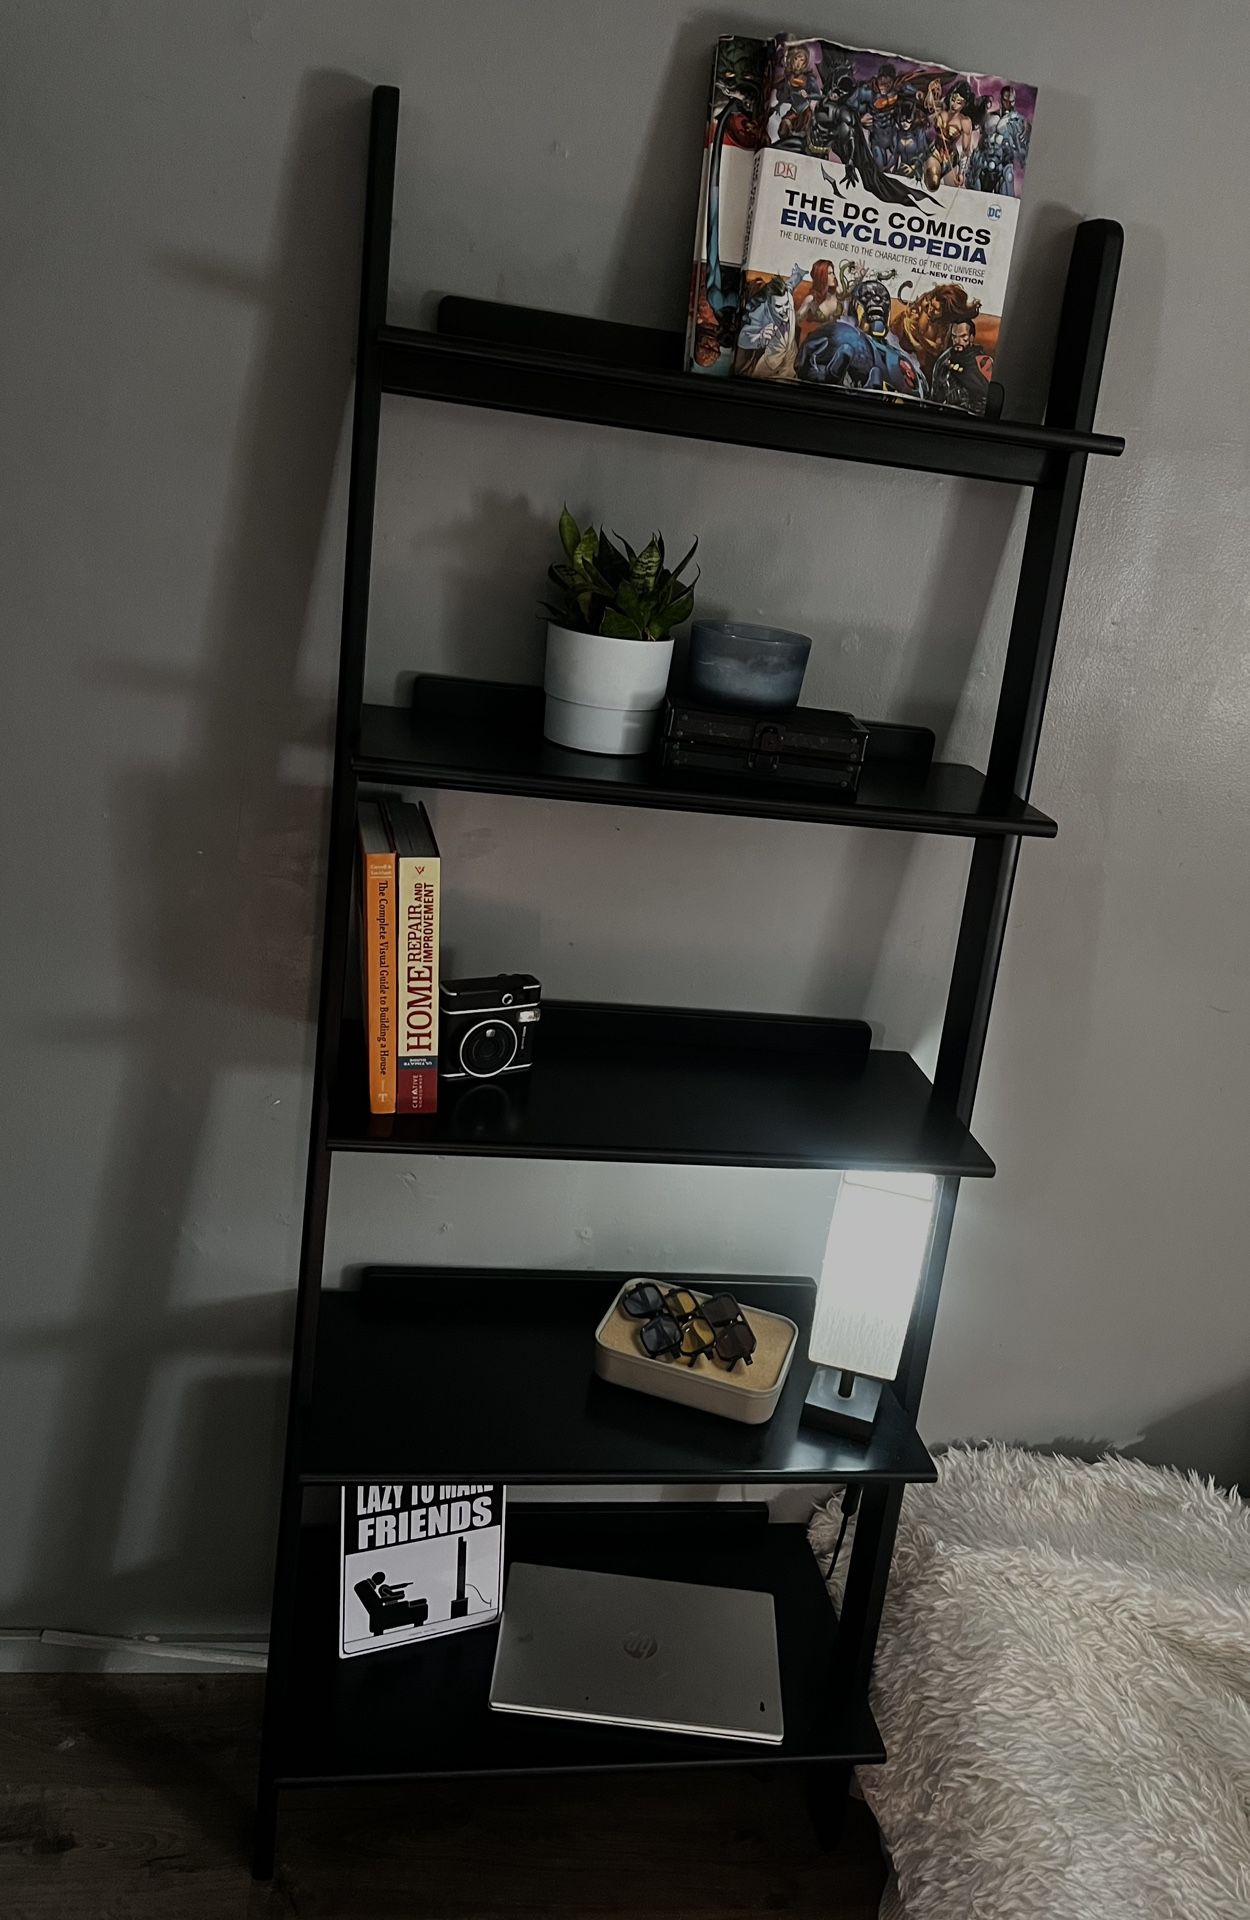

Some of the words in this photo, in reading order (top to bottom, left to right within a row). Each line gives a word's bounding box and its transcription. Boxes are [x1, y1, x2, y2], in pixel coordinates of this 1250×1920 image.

[777, 163, 794, 176] DK
[785, 190, 834, 215] THE
[843, 203, 879, 224] DC
[888, 212, 992, 246] COMICS
[988, 206, 1002, 219] DC
[780, 208, 987, 265] ENCYCLOPEDIA
[779, 230, 792, 240] THE
[794, 232, 828, 247] DEFINITIVE
[830, 240, 850, 252] GUIDE
[850, 244, 860, 254] TO
[861, 247, 873, 257] THE
[874, 250, 918, 266] CHARACTERS
[918, 258, 928, 267] OF
[930, 260, 941, 270] THE
[942, 262, 953, 272] DC
[954, 264, 986, 278] UNIVERSE
[911, 267, 948, 281] ALL-NEW
[950, 274, 984, 285] EDITION
[379, 880, 389, 897] The
[414, 882, 423, 902] AND
[376, 898, 389, 940] Complete
[408, 904, 422, 962] REPAIR
[423, 882, 434, 962] IMPROVEMENT
[380, 942, 389, 968] Visual
[380, 970, 389, 994] Guide
[380, 996, 388, 1005] to
[406, 966, 432, 1052] HOME
[377, 1006, 390, 1042] Building
[380, 1050, 389, 1075] House
[356, 1485, 404, 1516] LAZY
[358, 1496, 492, 1550] FRIENDS
